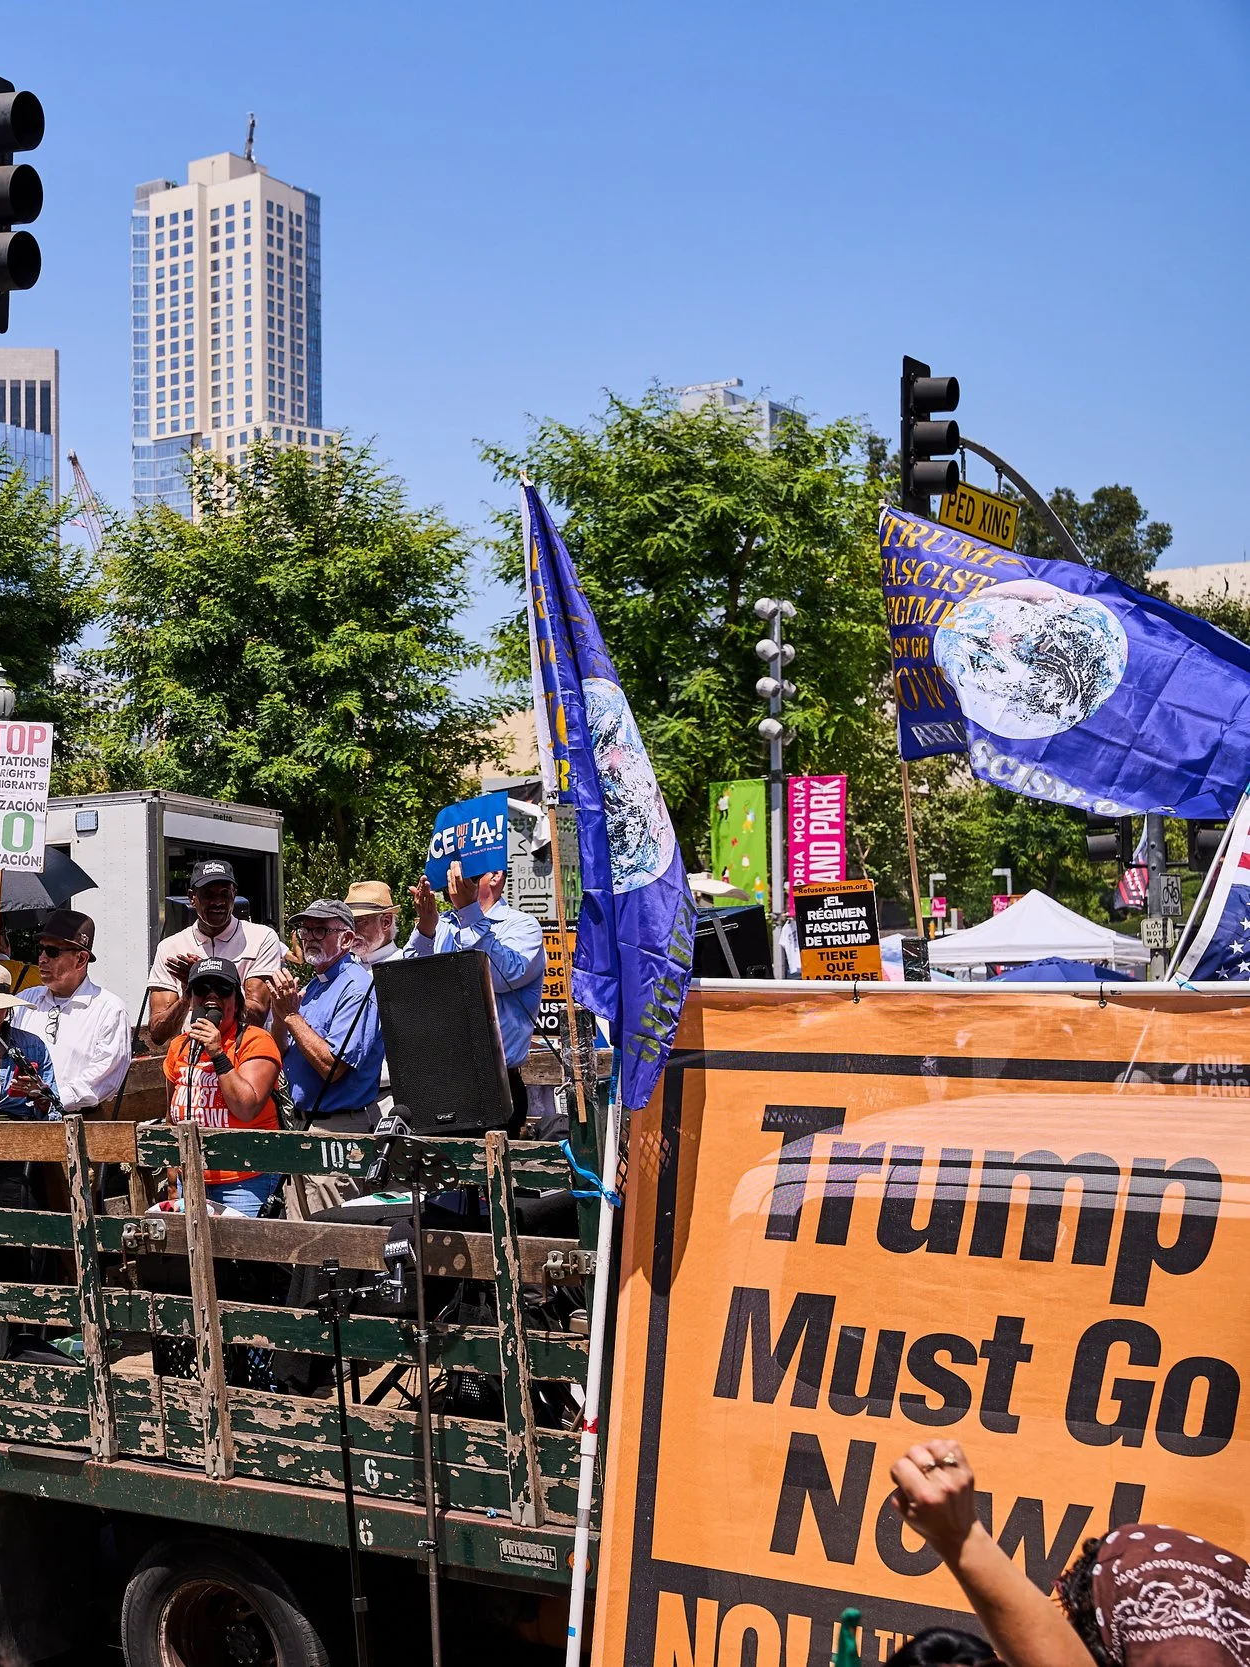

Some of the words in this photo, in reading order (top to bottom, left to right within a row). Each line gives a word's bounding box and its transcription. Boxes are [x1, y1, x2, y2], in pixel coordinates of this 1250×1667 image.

[946, 491, 976, 526] PED
[979, 505, 1012, 539] XING
[894, 638, 909, 658] ST
[910, 636, 930, 659] GO
[0, 769, 36, 778] RIGHTS
[793, 780, 806, 842] MOLINA
[809, 779, 841, 835] PARK
[456, 822, 470, 838] OUT
[470, 814, 504, 847] LA!
[457, 836, 466, 850] OF
[809, 841, 841, 884] AND
[798, 882, 868, 894] RefuseFascism.org
[824, 896, 844, 910] ¡EL
[807, 906, 867, 921] RÉGIMEN
[805, 920, 868, 934] FASCISTA
[805, 936, 823, 948] DE
[826, 932, 872, 946] TRUMP
[817, 950, 859, 961] TIENE
[826, 962, 855, 973] QUE
[534, 1016, 558, 1028] NO
[760, 1104, 1222, 1306] Trump
[714, 1286, 1033, 1434] Must
[1064, 1318, 1241, 1458] Go
[364, 1458, 379, 1488] 6
[358, 1517, 374, 1546] 6
